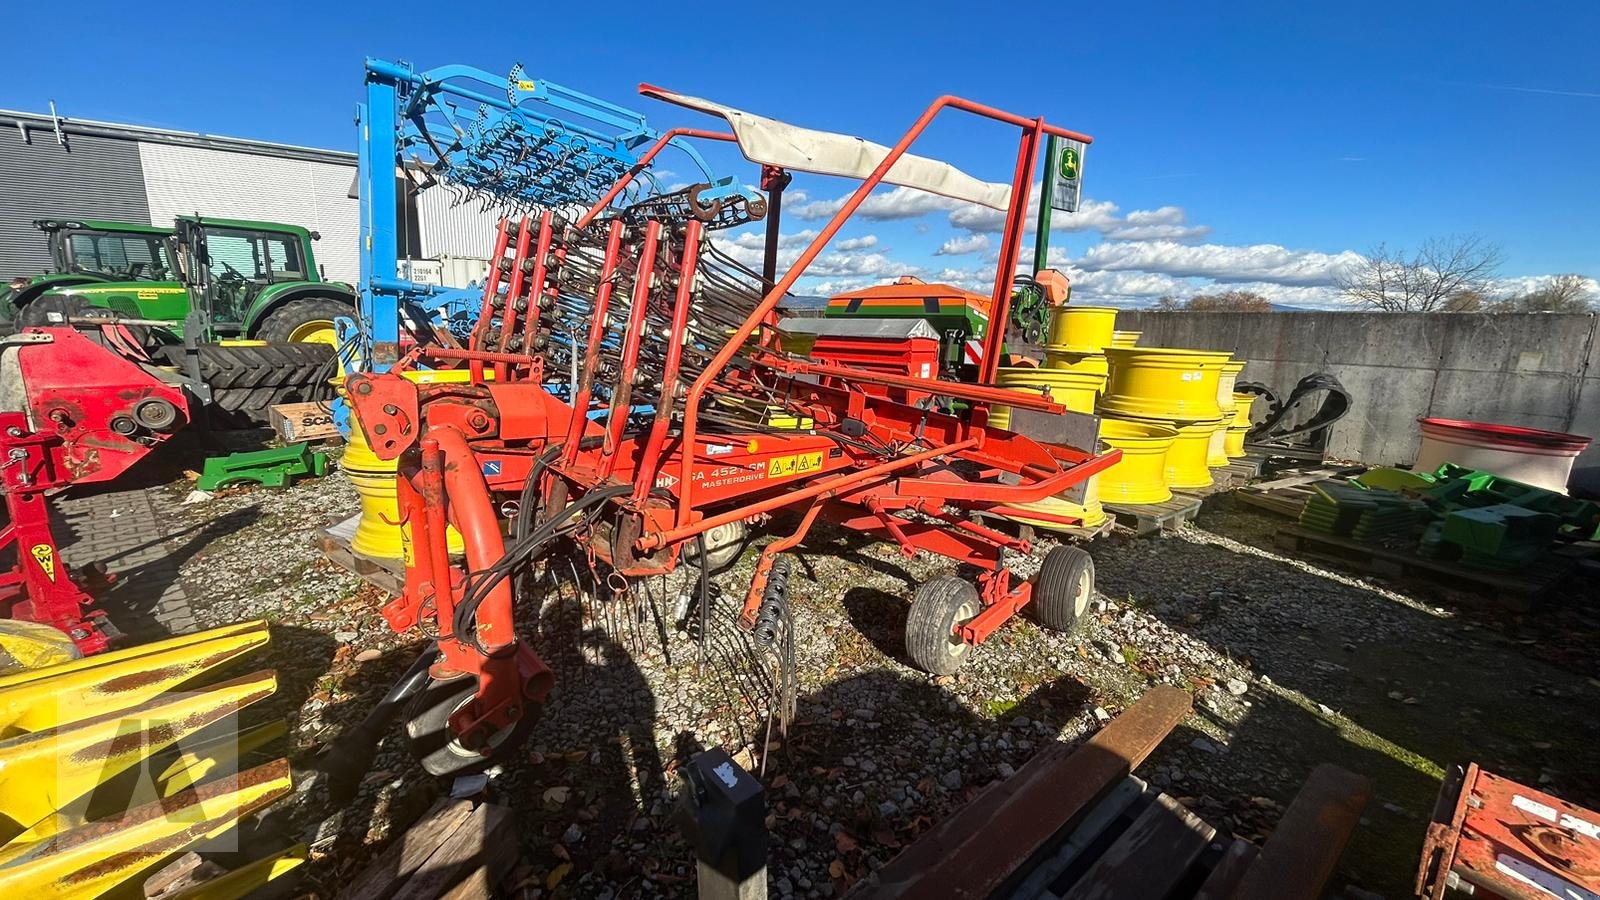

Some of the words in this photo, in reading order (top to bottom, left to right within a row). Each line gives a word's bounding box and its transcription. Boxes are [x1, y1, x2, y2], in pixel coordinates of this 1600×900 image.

[302, 416, 334, 427] SCA
[656, 476, 673, 488] HN
[702, 473, 765, 488] MASTERDRIVE
